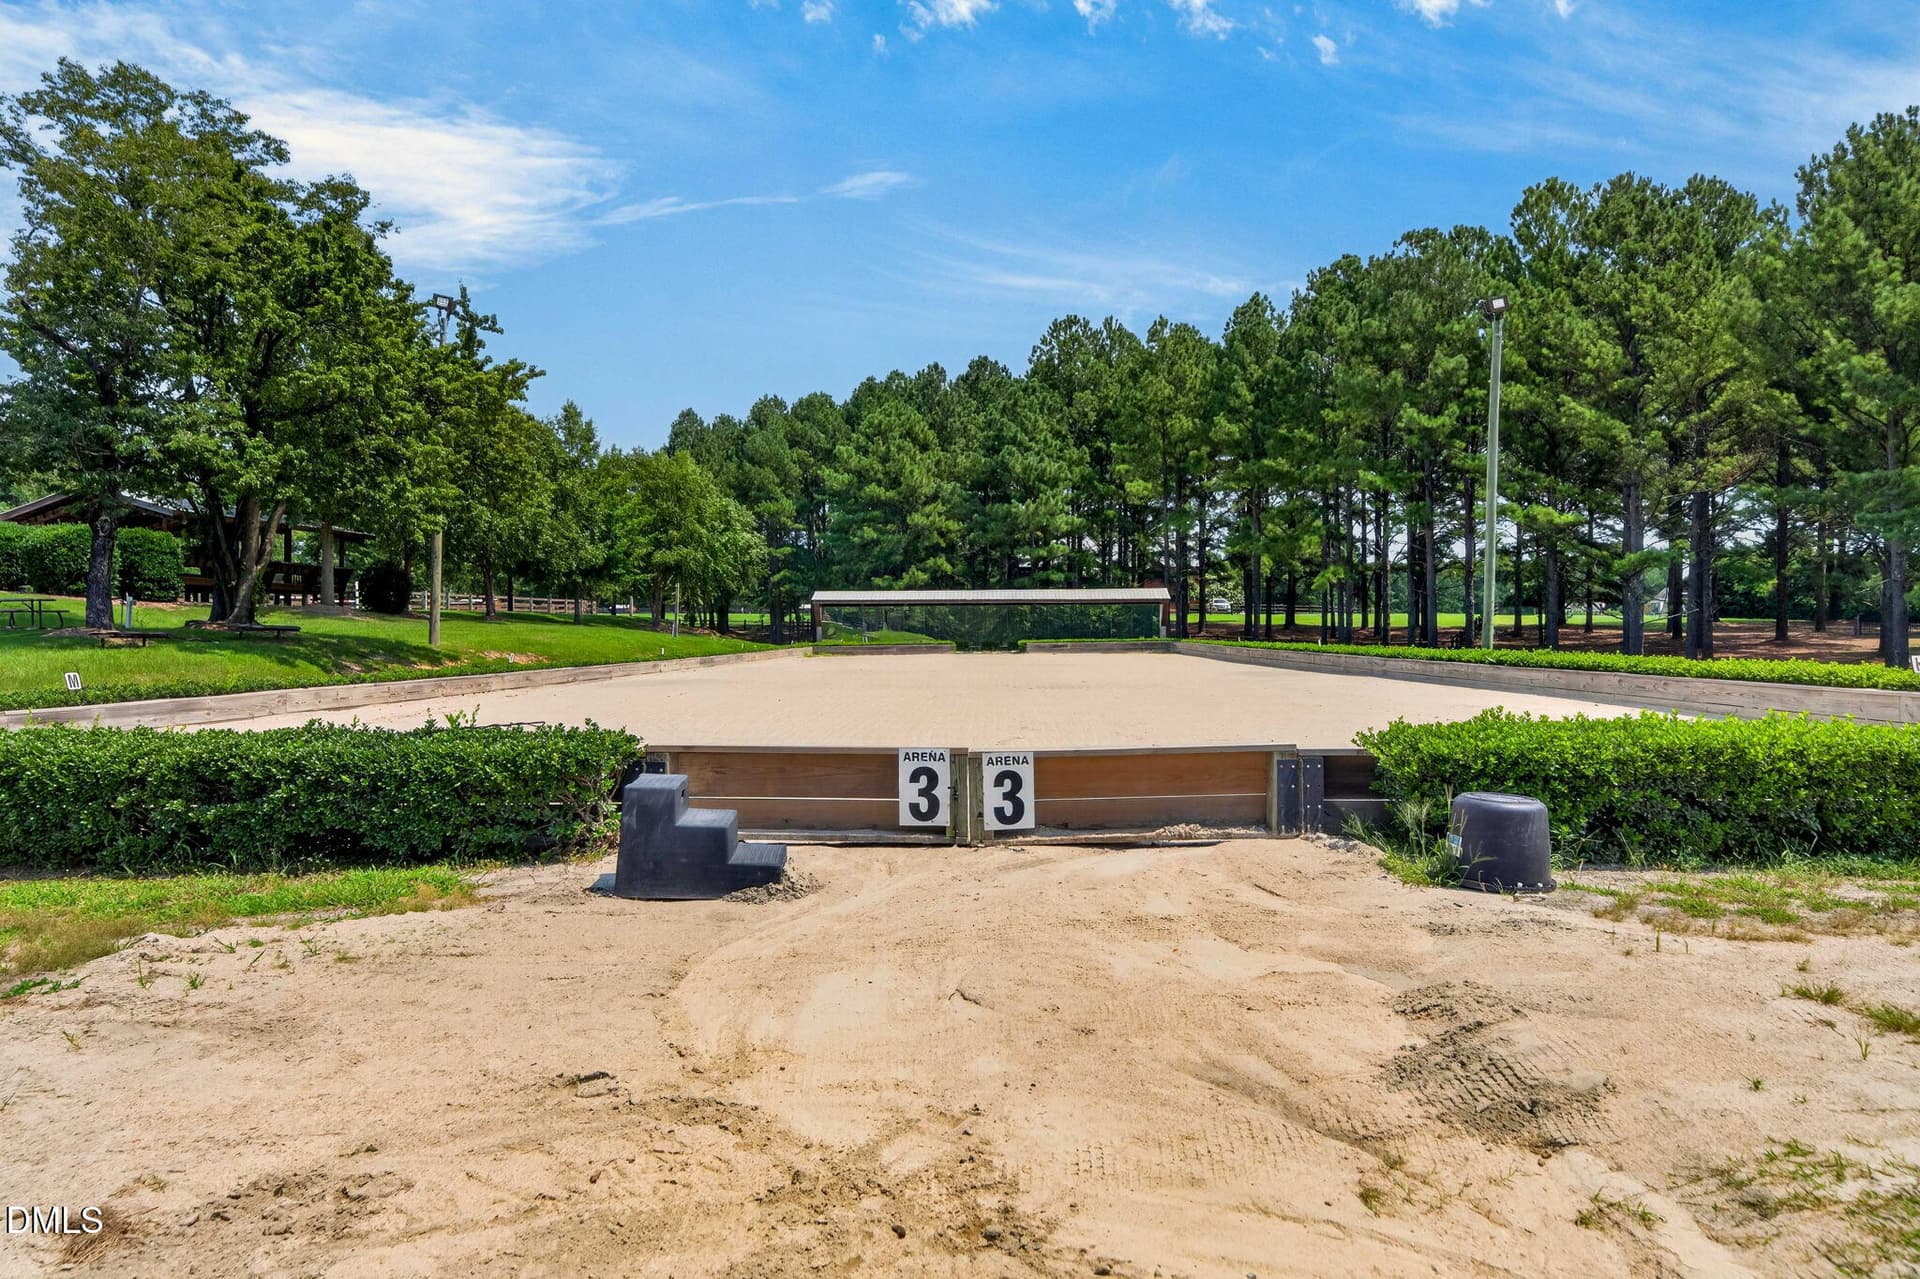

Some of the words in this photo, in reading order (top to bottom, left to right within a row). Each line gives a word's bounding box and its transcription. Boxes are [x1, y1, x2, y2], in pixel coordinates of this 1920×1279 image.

[67, 674, 80, 688] M
[903, 752, 946, 762] ARENA
[986, 756, 1029, 766] ARENA
[908, 766, 940, 822] 3
[993, 769, 1025, 826] 3
